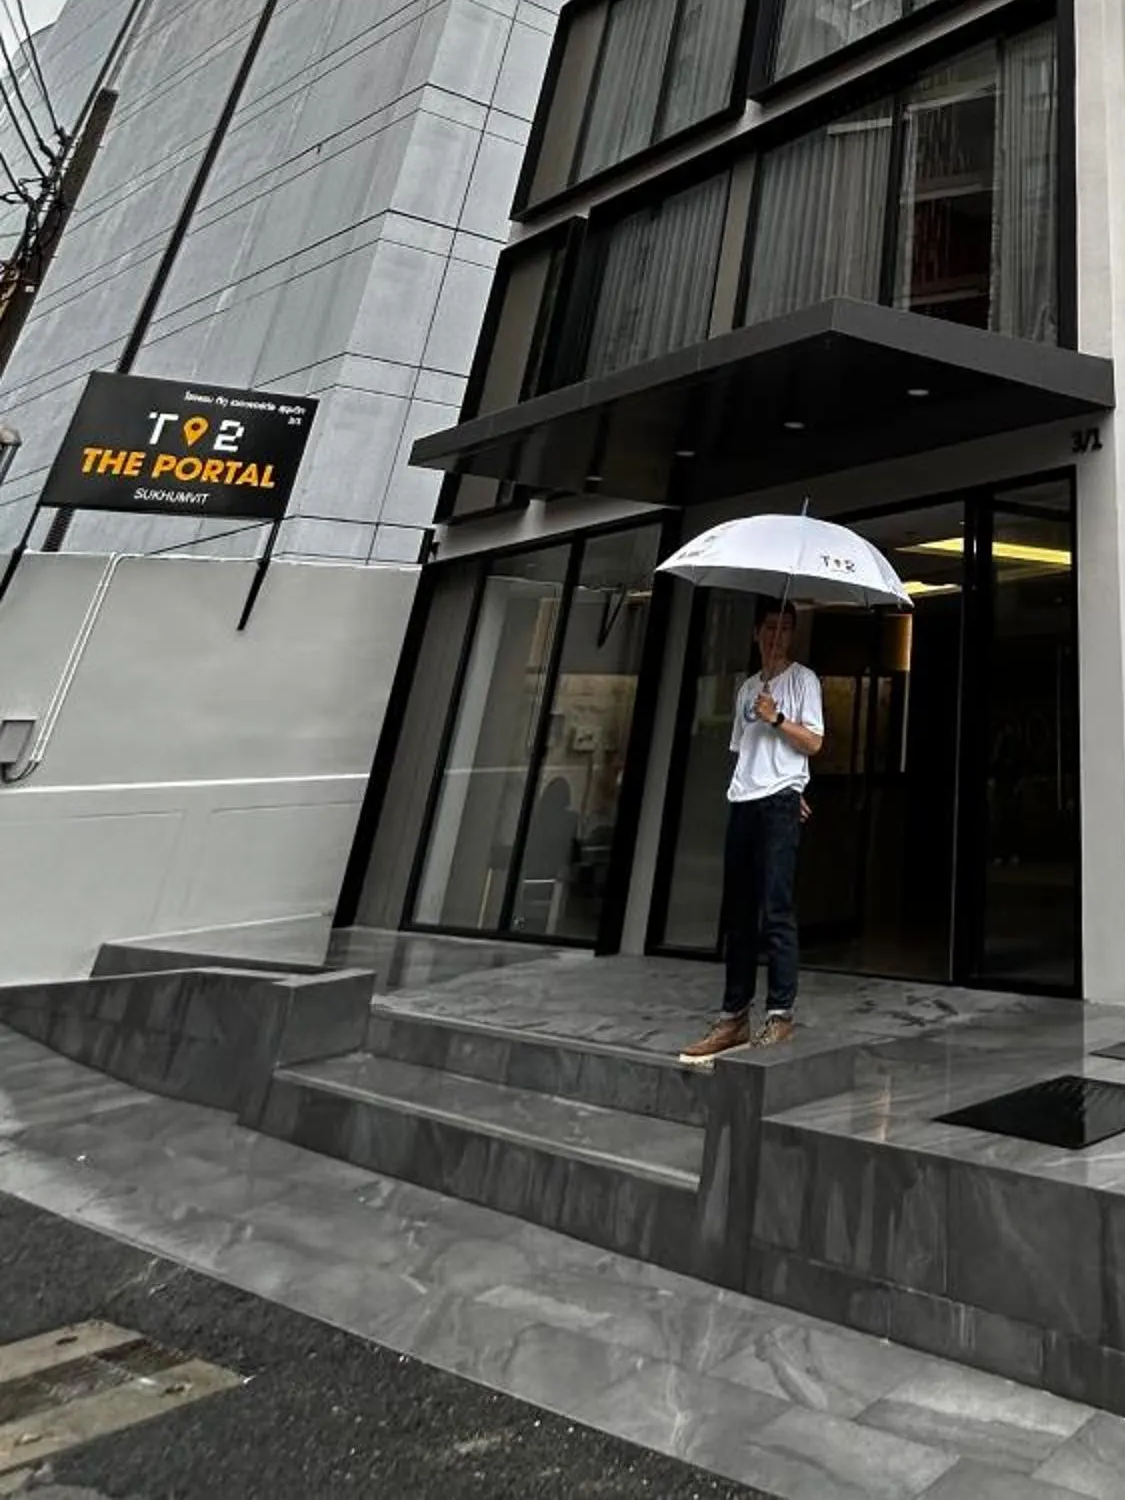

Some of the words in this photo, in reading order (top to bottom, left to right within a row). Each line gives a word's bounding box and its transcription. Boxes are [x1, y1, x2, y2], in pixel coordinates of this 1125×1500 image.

[147, 411, 178, 445] T
[213, 419, 245, 453] 2
[1070, 426, 1103, 455] 3/1
[81, 447, 146, 477] THE
[151, 453, 276, 489] PORTAL
[133, 487, 211, 505] SUKHUMVIT
